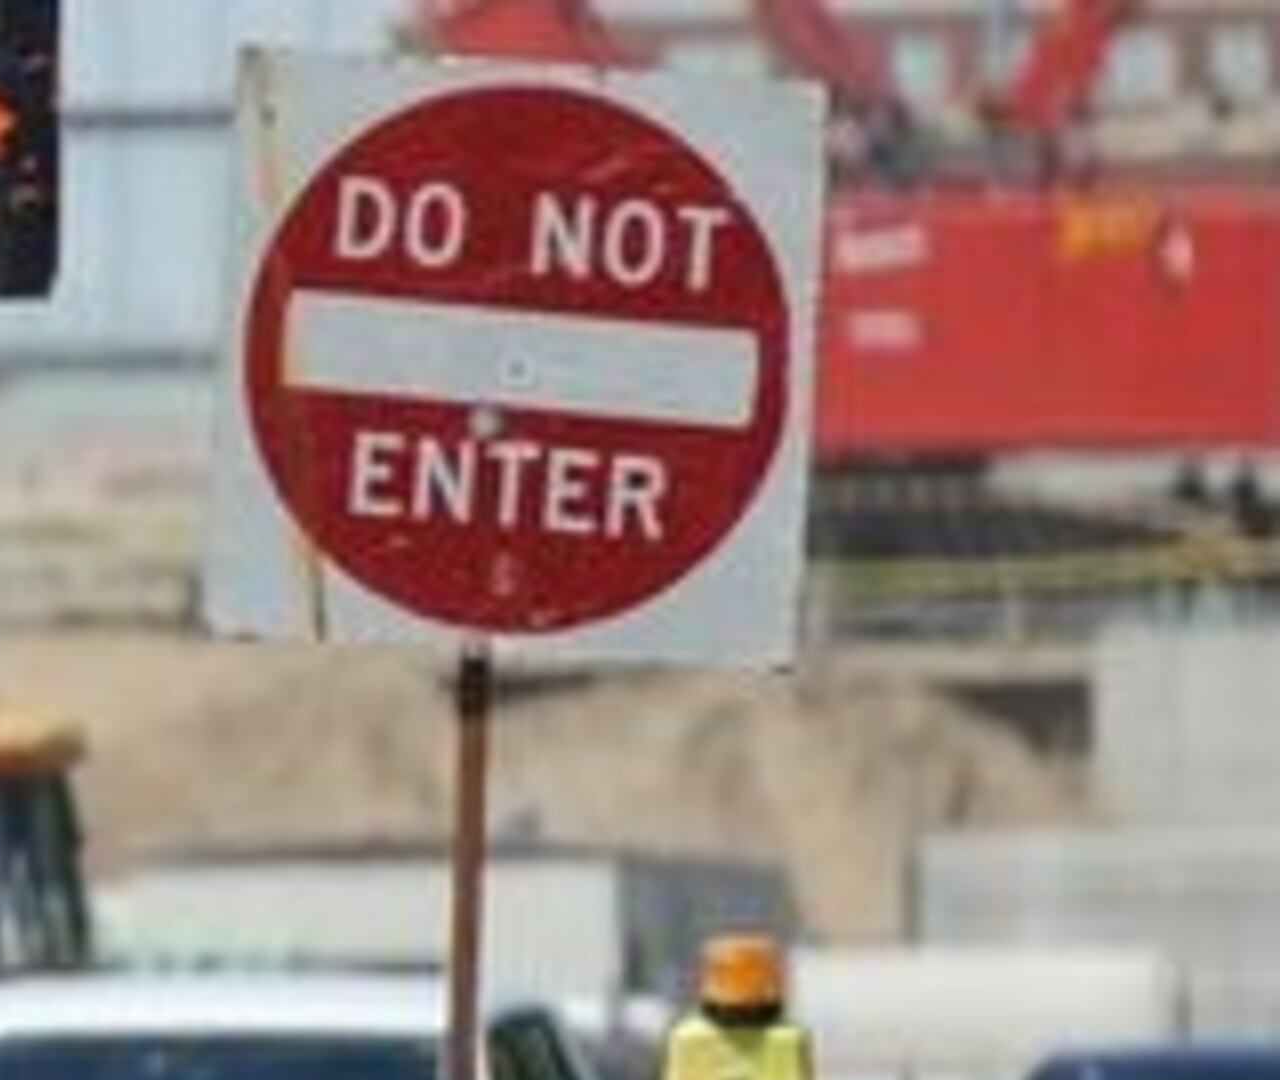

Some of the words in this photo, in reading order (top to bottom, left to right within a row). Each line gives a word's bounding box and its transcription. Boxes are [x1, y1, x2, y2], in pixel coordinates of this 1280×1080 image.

[334, 177, 465, 266] DO
[529, 193, 730, 291] NOT
[346, 431, 669, 541] ENTER
